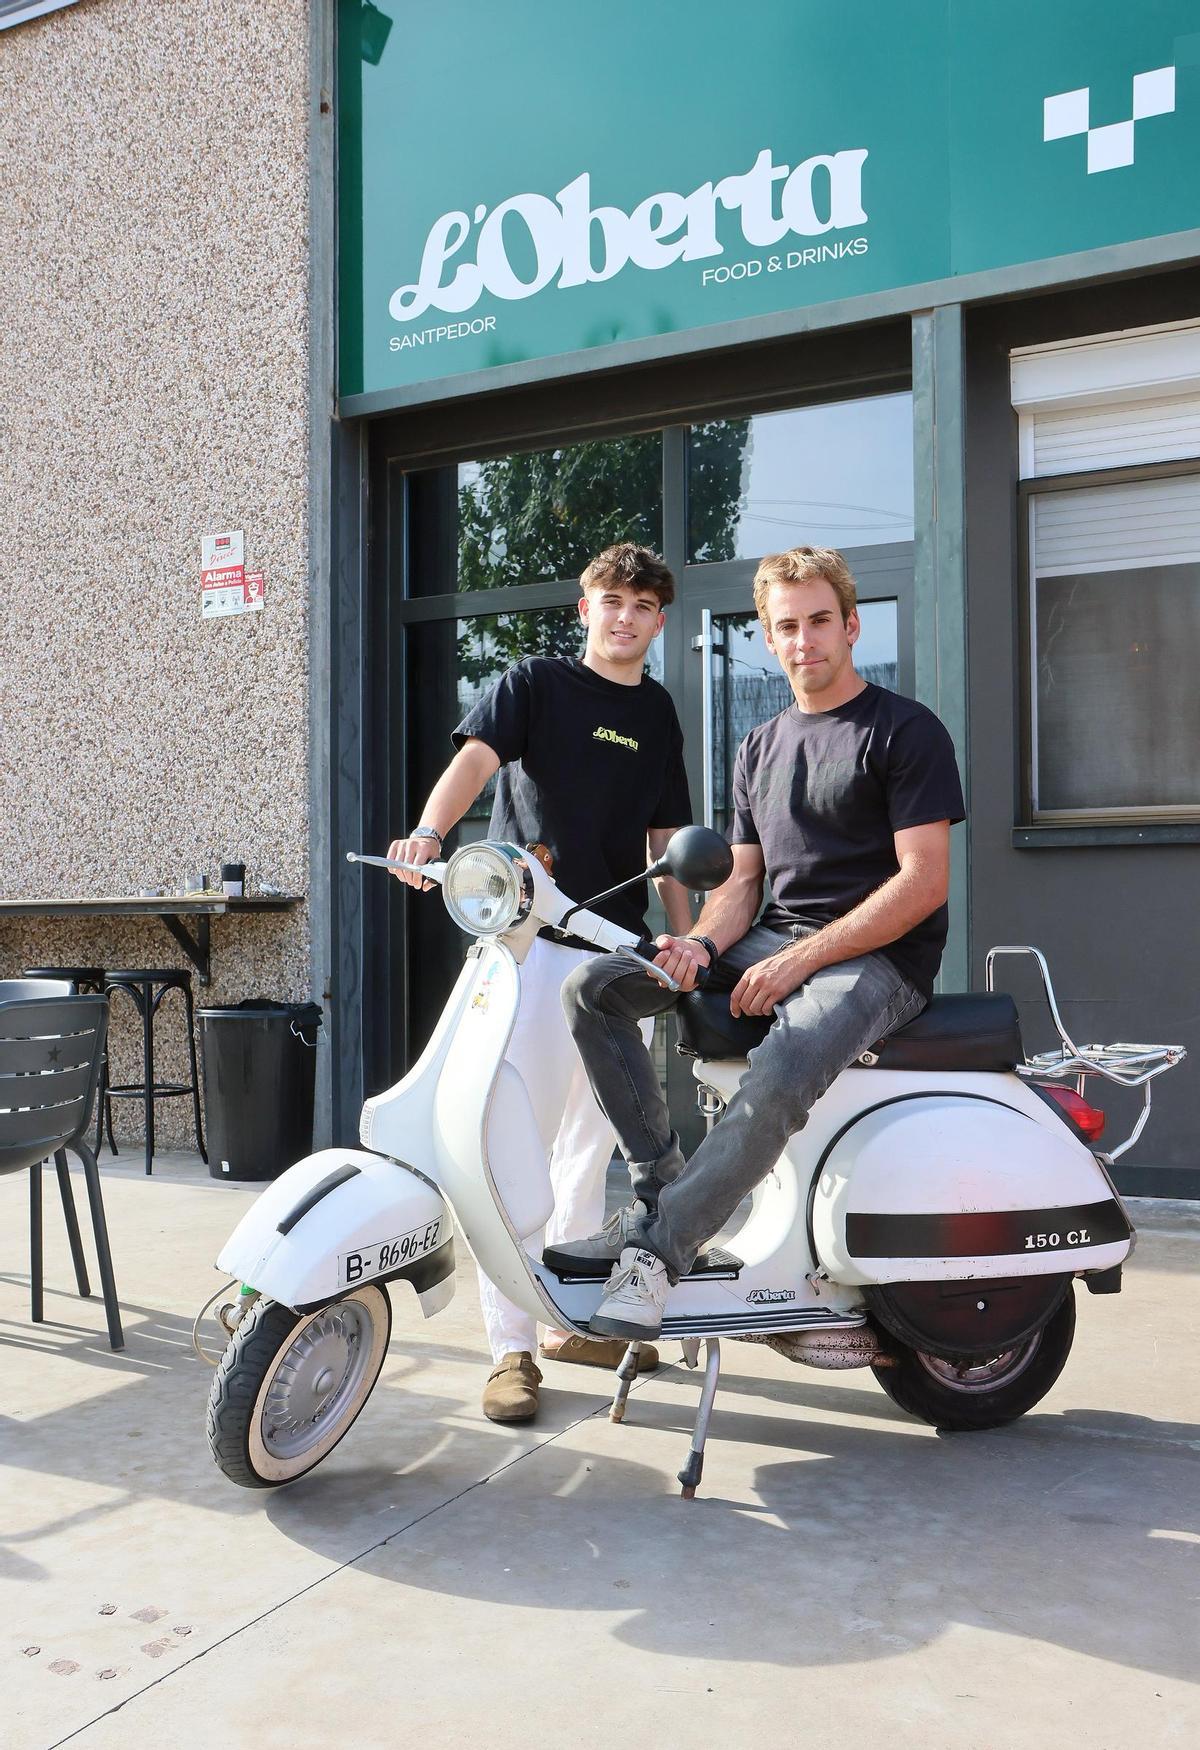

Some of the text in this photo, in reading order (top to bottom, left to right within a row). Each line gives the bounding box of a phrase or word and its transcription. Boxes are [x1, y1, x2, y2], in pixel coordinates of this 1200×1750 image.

[389, 149, 869, 322] L'Oberta
[702, 238, 869, 287] FOOD & DRINKS
[389, 316, 497, 352] SANTPEDOR
[205, 570, 242, 583] Alarma
[378, 1221, 440, 1271] 8696-EZ
[1024, 1229, 1091, 1249] 150 CL
